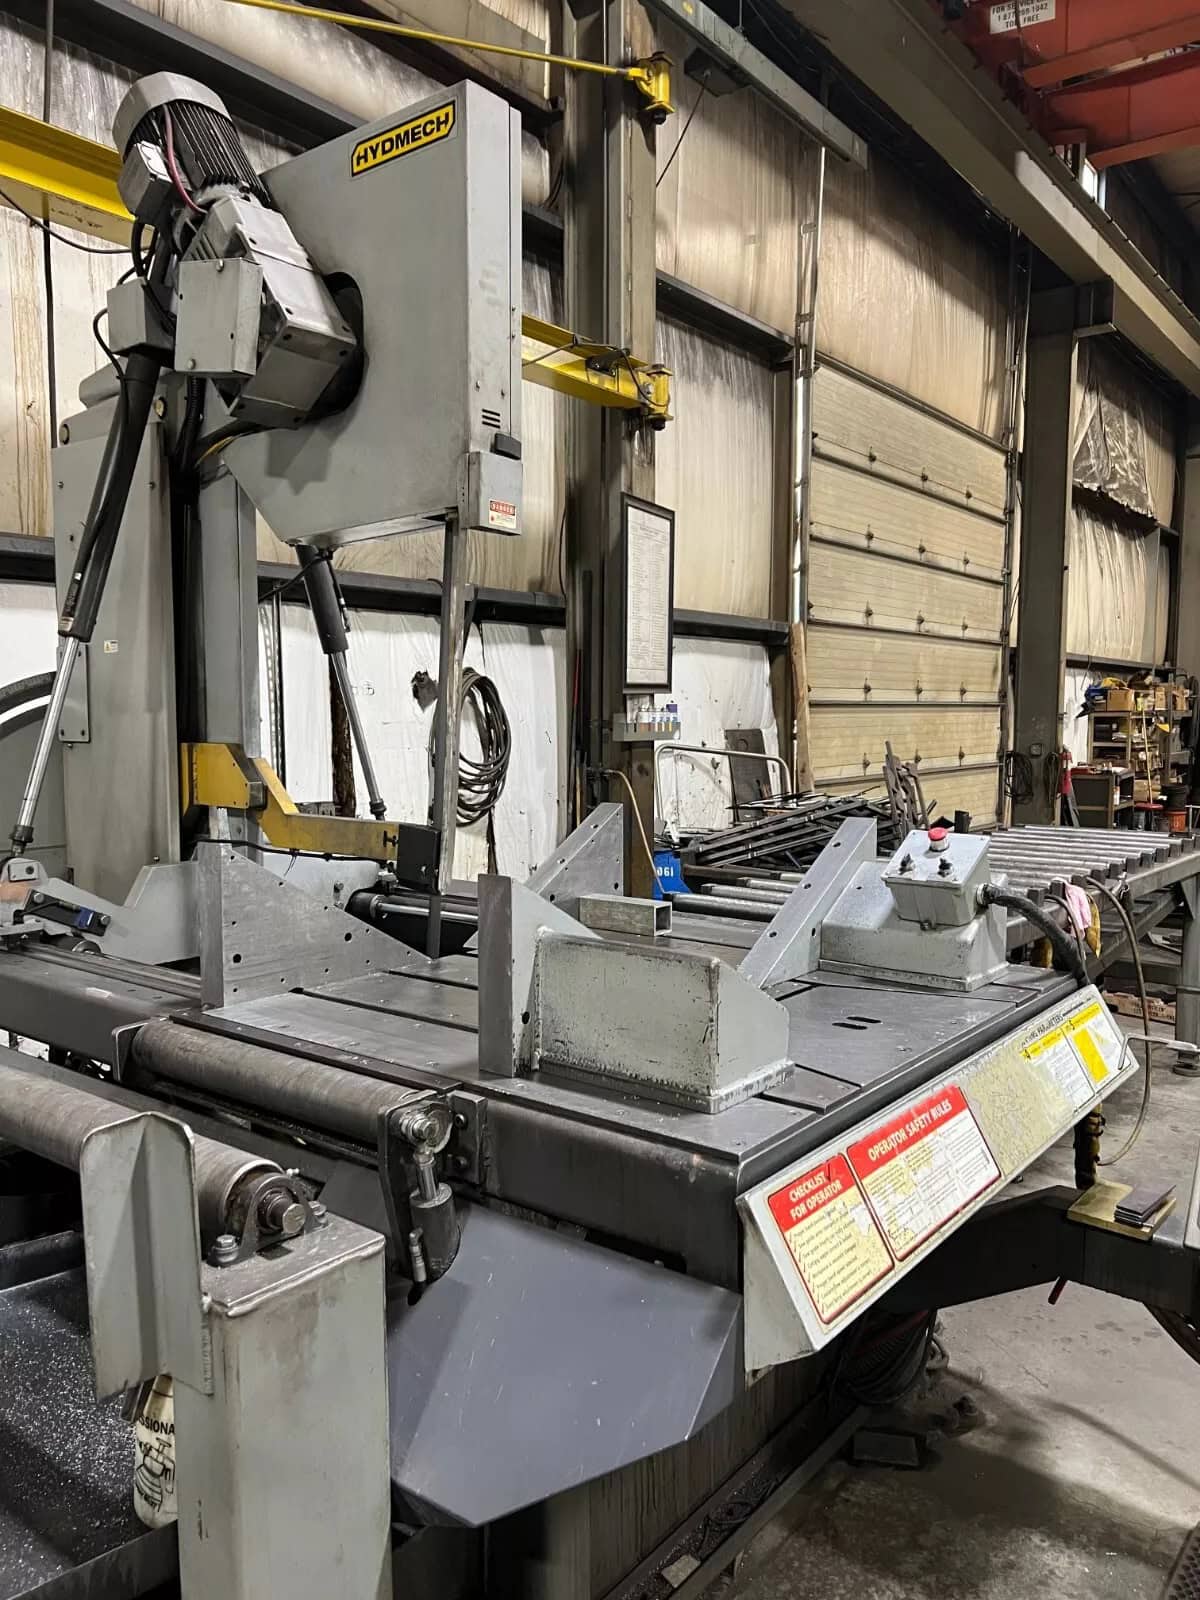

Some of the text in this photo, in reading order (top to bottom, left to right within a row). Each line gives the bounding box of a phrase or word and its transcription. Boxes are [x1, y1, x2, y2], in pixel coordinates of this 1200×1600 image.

[1023, 14, 1040, 24] FREE
[356, 111, 450, 167] HYDMECH
[867, 1098, 953, 1162] OPERATOR SAFETY RULES
[789, 1171, 826, 1203] CHECKLIST
[790, 1203, 808, 1222] FOR
[805, 1179, 843, 1211] OPERATOR
